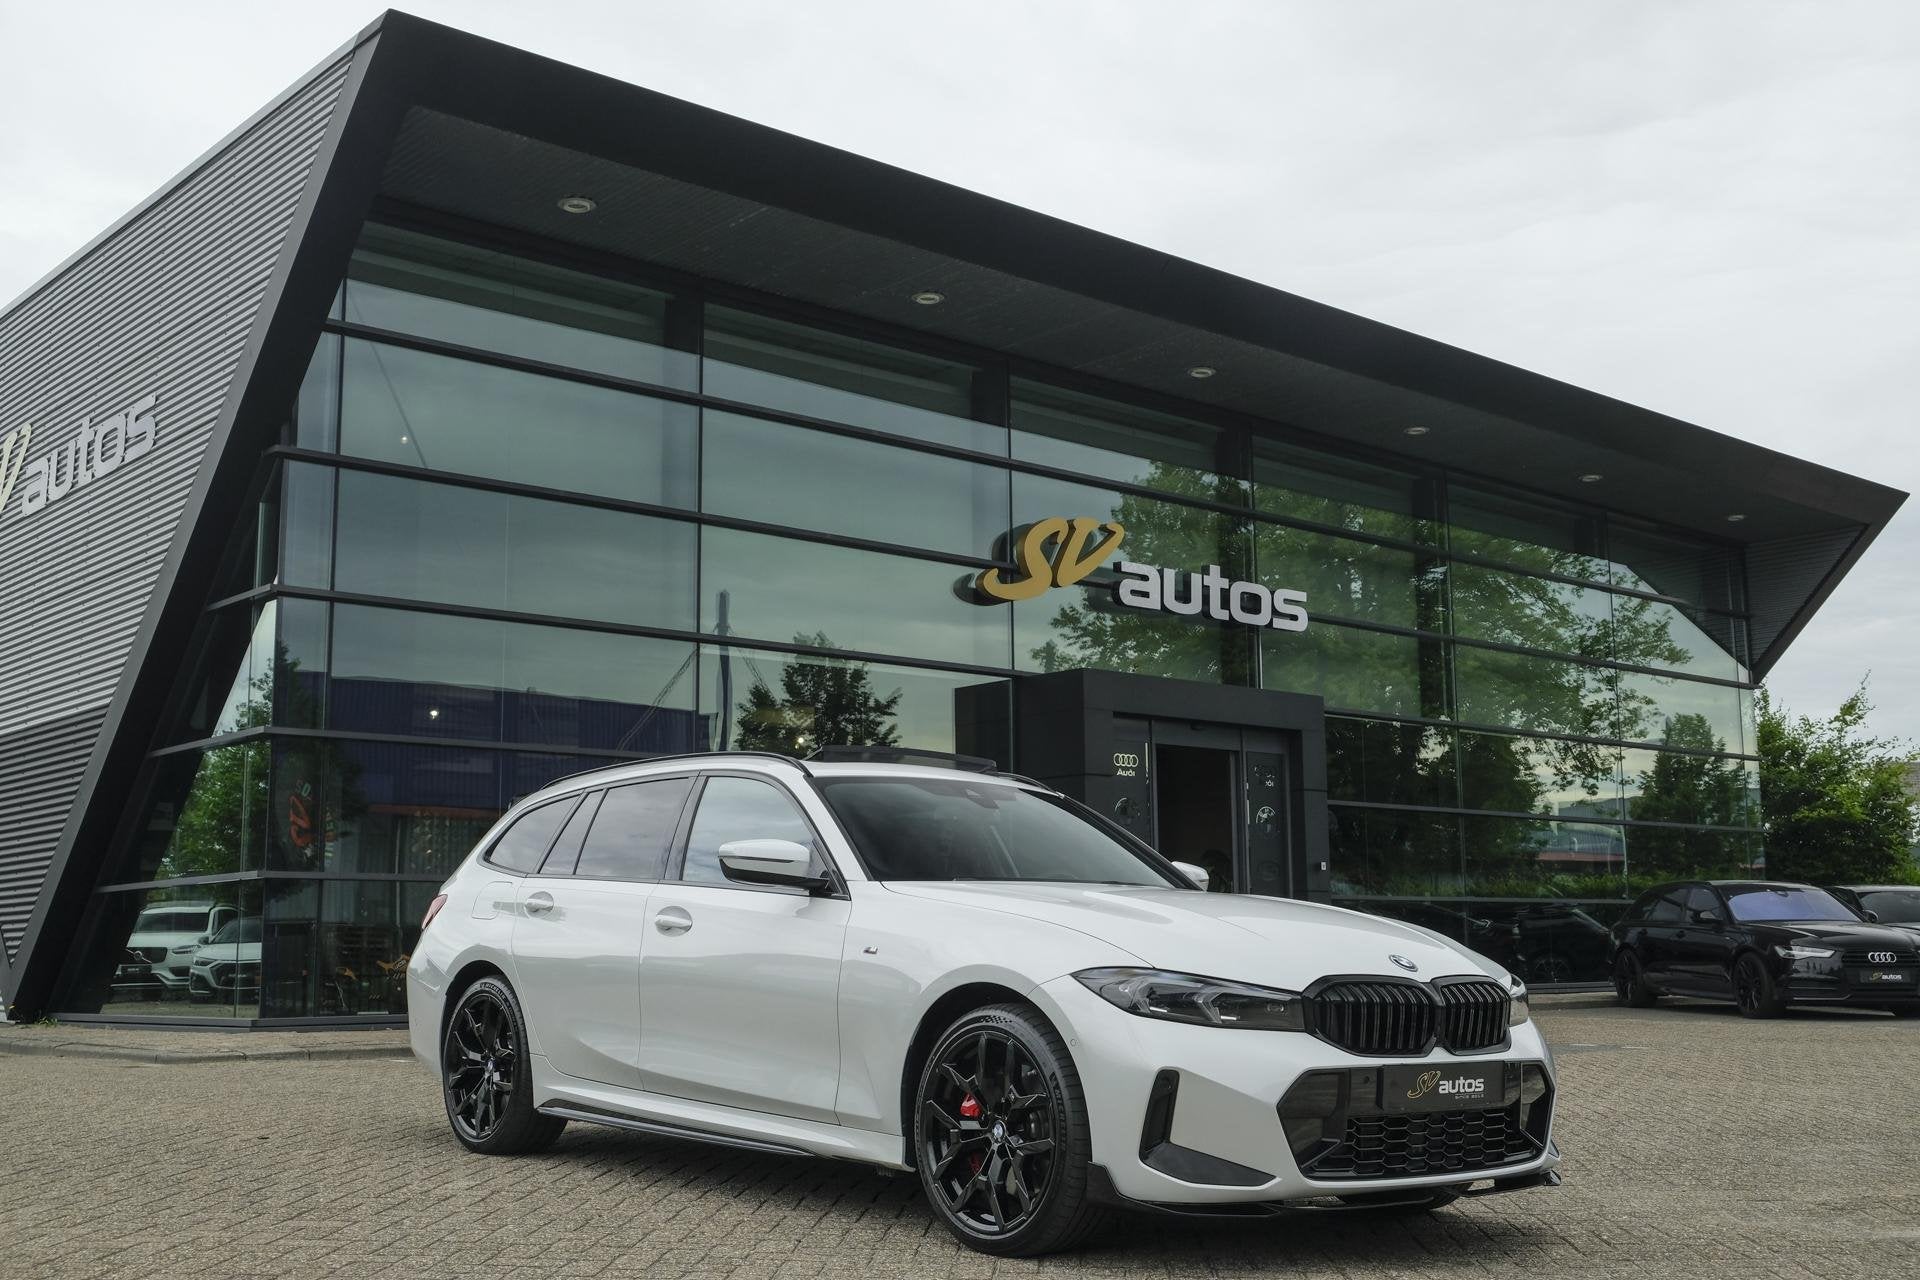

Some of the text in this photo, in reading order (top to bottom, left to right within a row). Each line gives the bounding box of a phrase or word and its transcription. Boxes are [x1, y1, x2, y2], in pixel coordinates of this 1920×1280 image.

[22, 392, 157, 516] autos
[980, 516, 1309, 632] SV autos
[1116, 768, 1136, 777] Audi
[1406, 1070, 1485, 1099] SV autos
